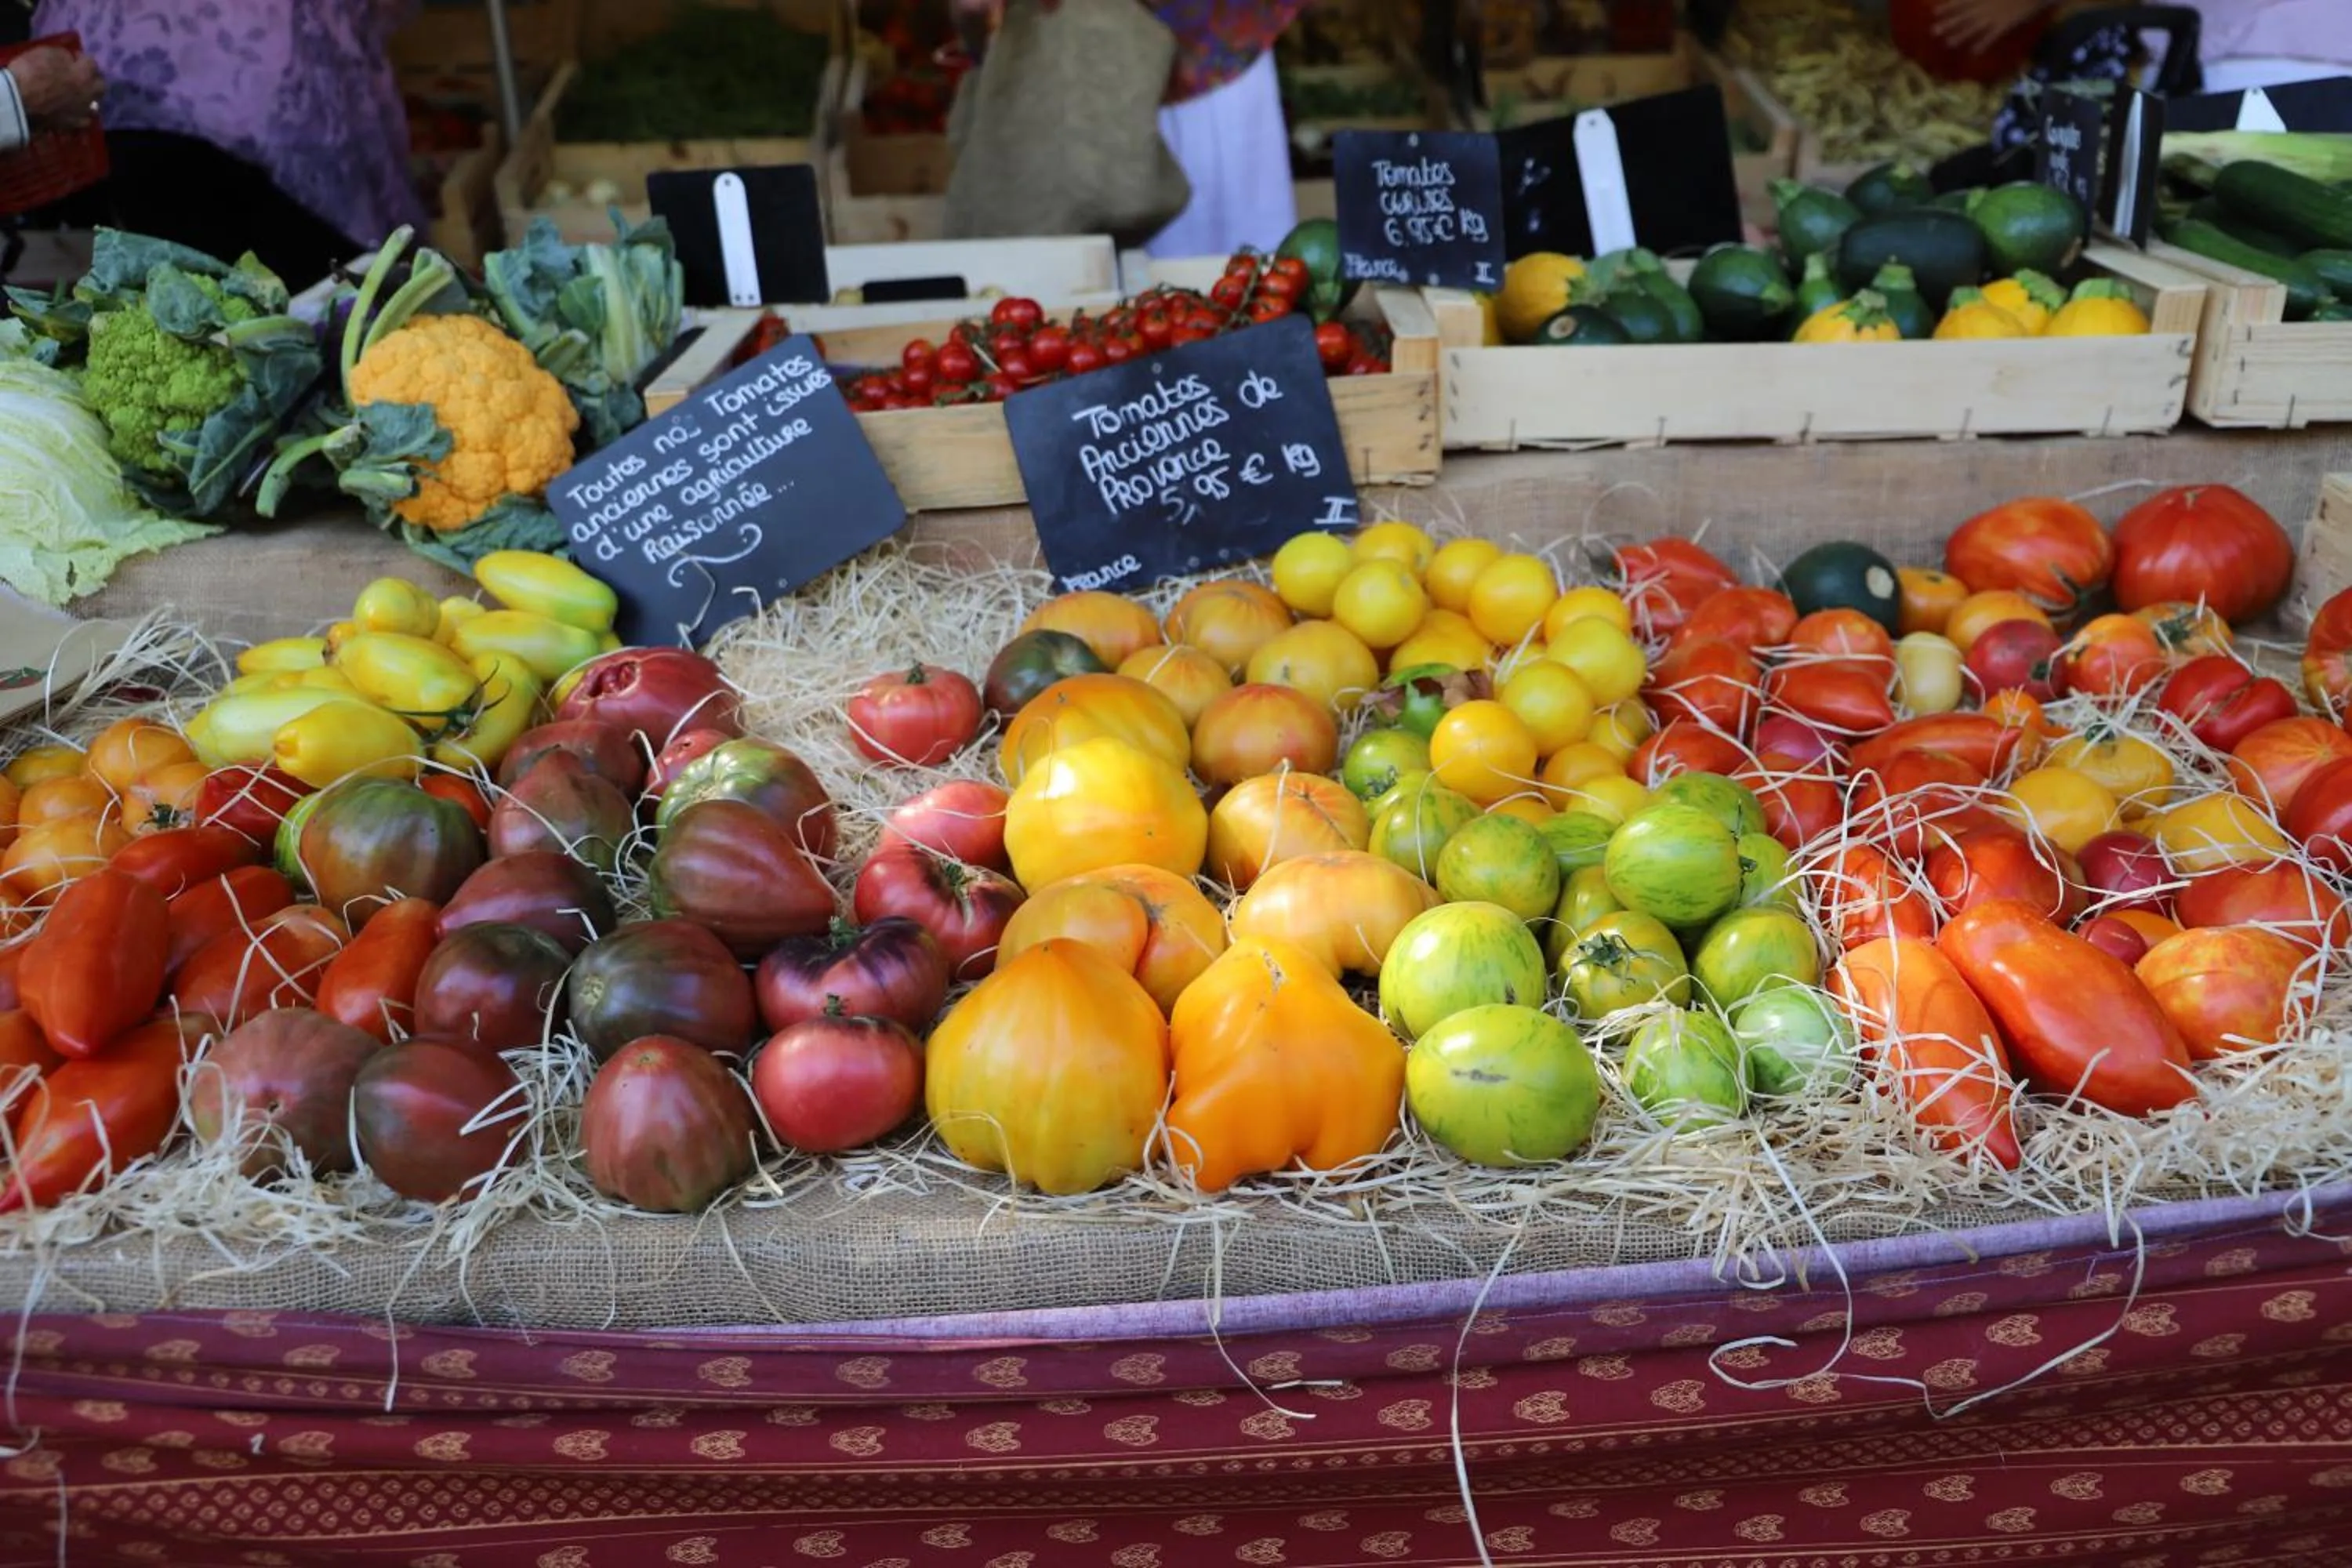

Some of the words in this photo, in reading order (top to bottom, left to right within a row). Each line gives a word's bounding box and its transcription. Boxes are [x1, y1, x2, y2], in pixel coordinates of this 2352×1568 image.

[1370, 156, 1456, 187] Tomates
[566, 455, 647, 509] Toutes
[704, 355, 813, 416] Tomates
[1071, 374, 1210, 440] Tomates
[1238, 369, 1283, 408] de
[1080, 397, 1230, 482] Anciennes
[572, 459, 693, 543] anciennes
[698, 412, 758, 463] sont
[763, 368, 832, 416] issues
[1239, 453, 1274, 484] €
